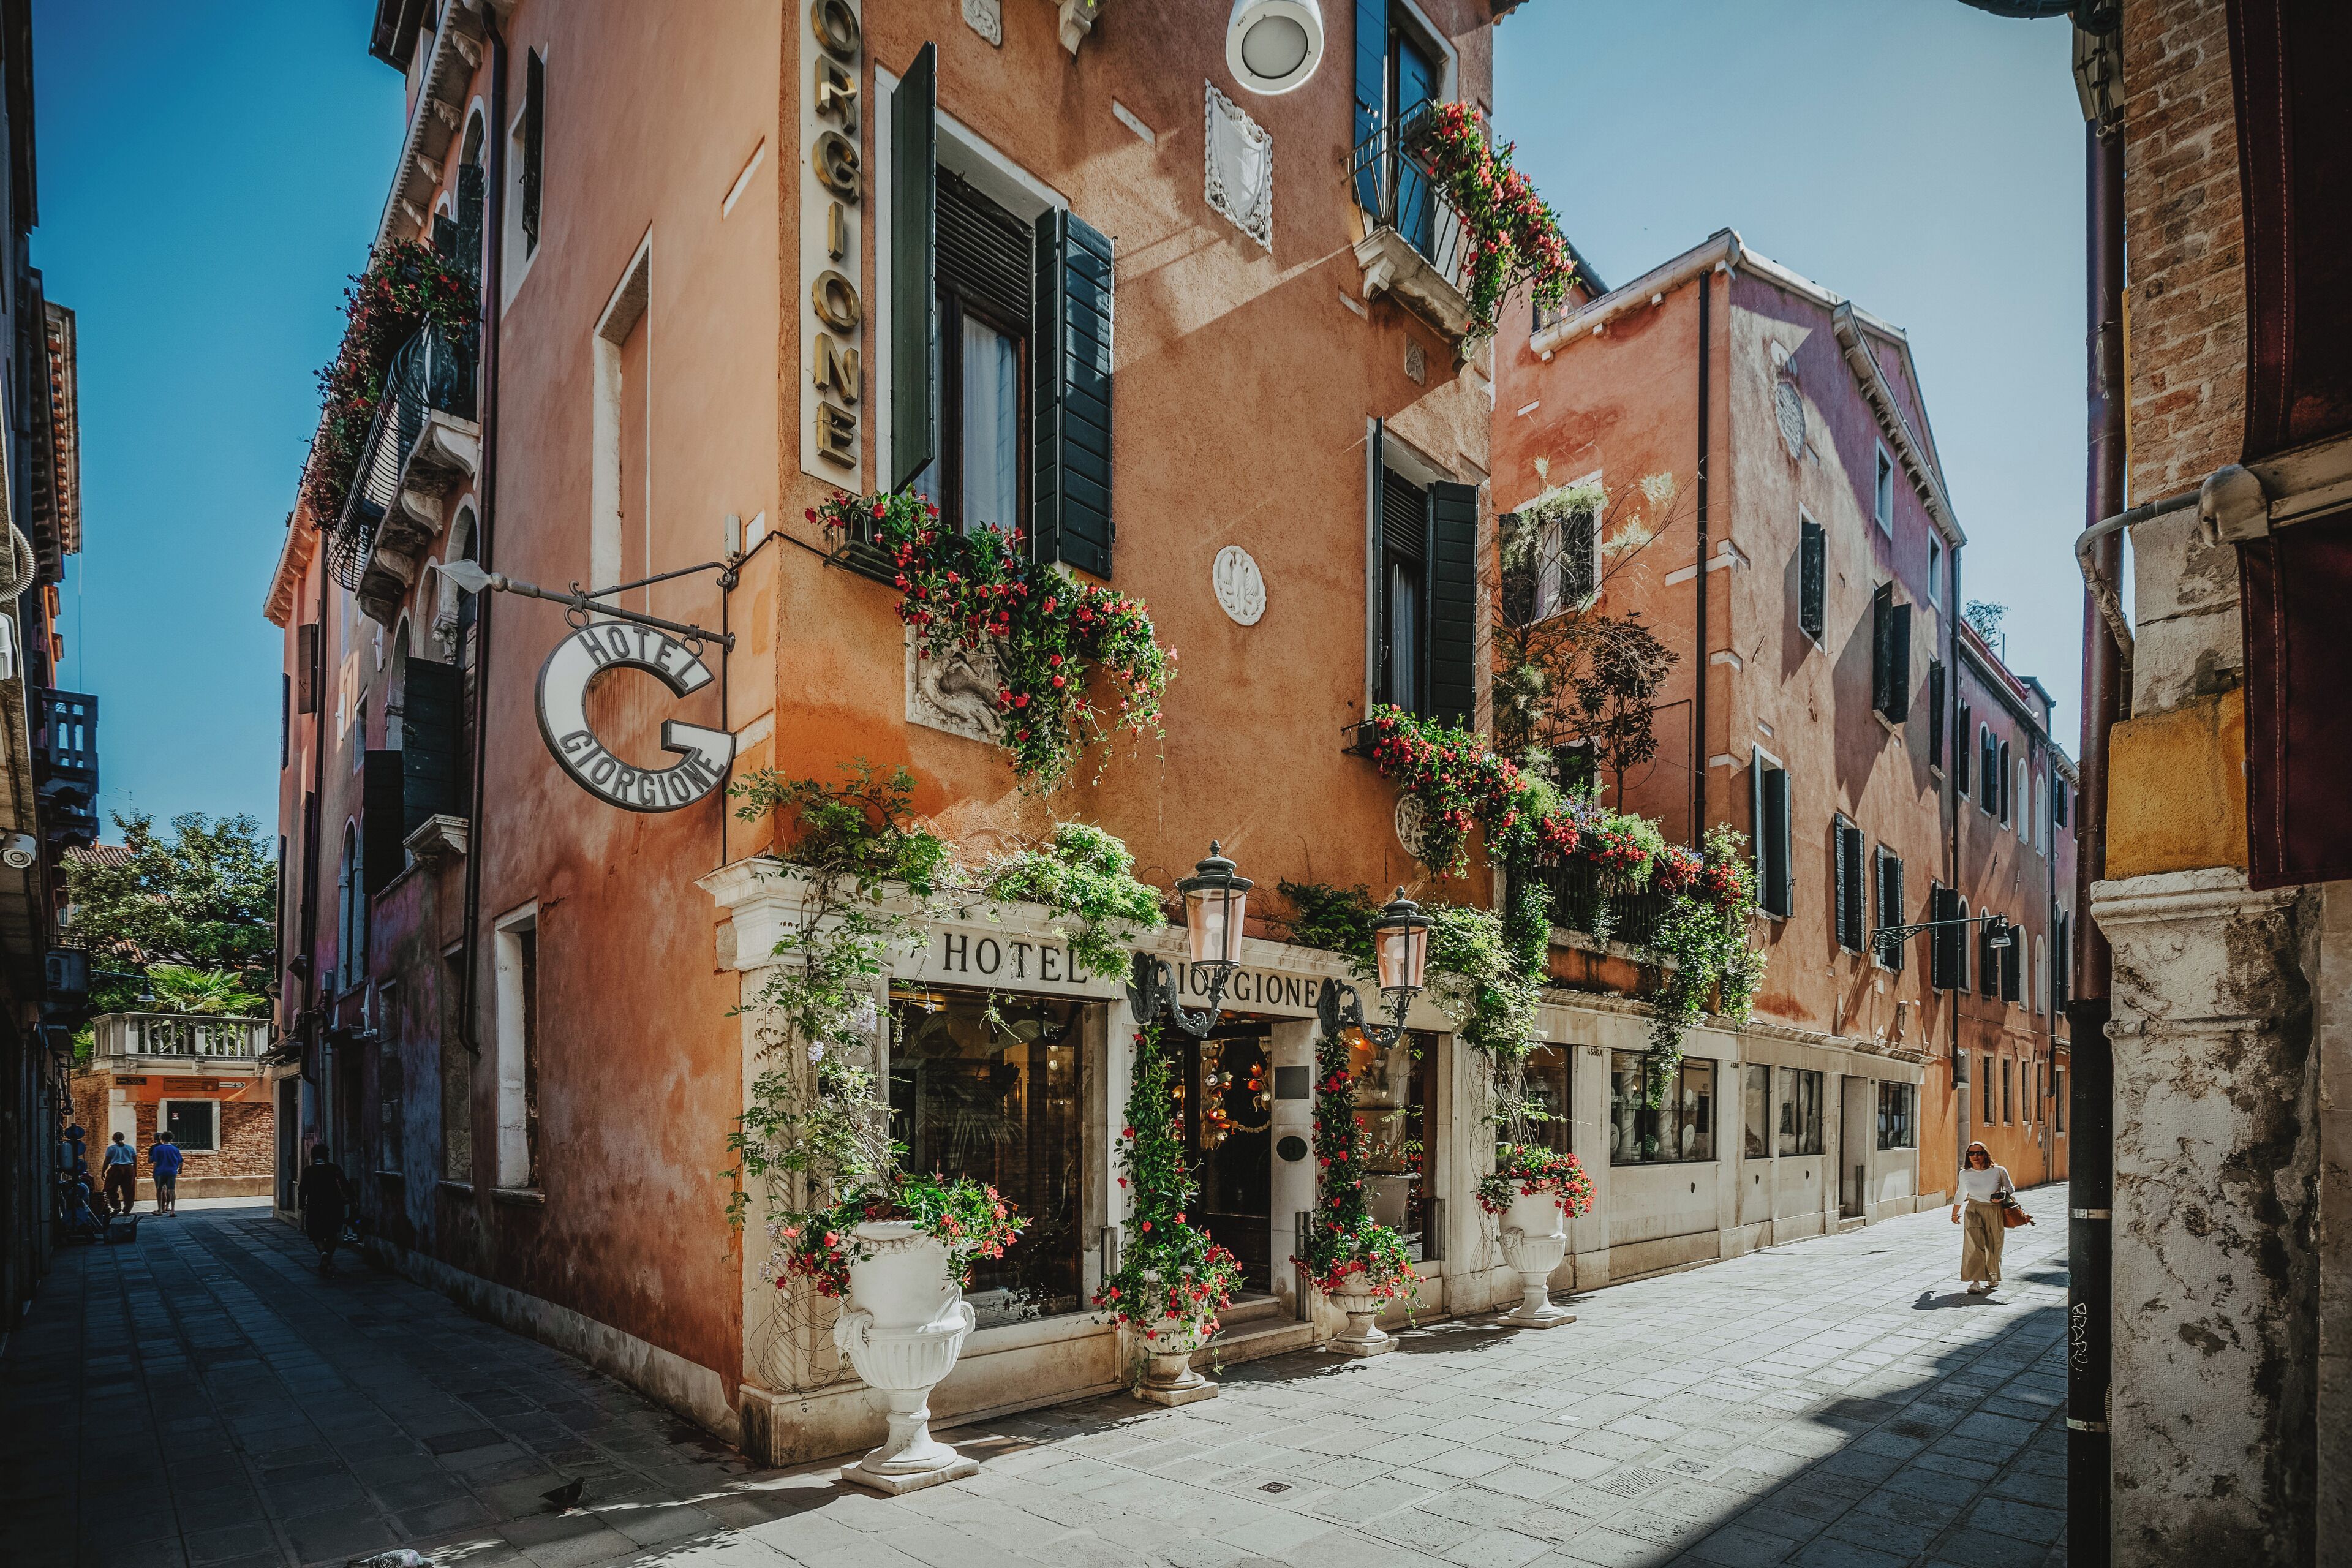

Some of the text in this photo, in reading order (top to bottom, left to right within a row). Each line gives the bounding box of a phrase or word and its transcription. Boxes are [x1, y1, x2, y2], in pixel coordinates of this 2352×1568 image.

[577, 625, 696, 688] HOTEL
[559, 729, 725, 805] GIORGIONE
[943, 933, 1088, 984] HOTEL
